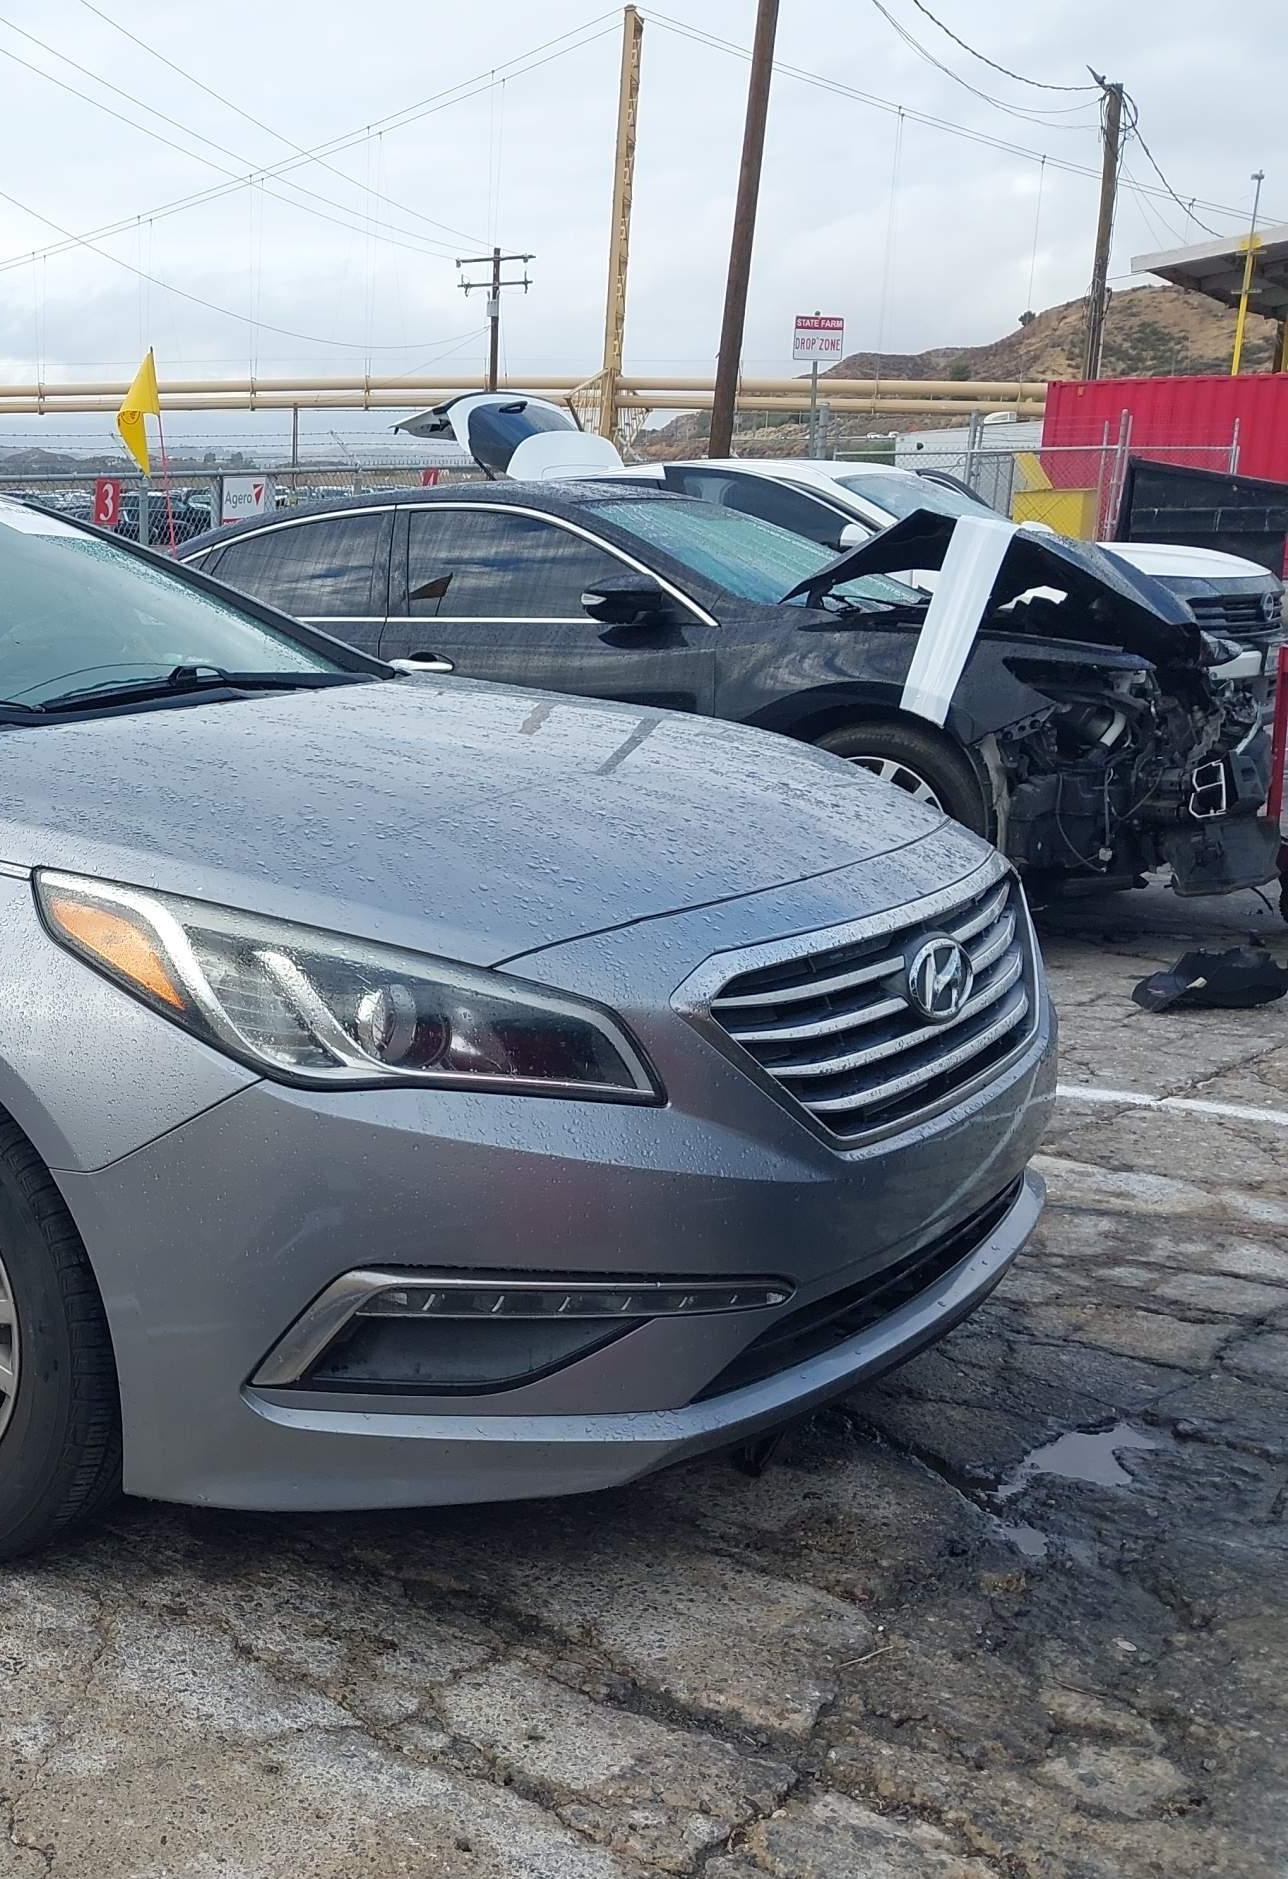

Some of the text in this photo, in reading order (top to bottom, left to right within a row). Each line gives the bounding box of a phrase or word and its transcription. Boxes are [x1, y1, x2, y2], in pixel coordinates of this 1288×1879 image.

[797, 319, 842, 328] STATE FARM
[795, 337, 840, 351] DROP ZONE
[99, 483, 114, 521] 3
[224, 490, 253, 509] Agero
